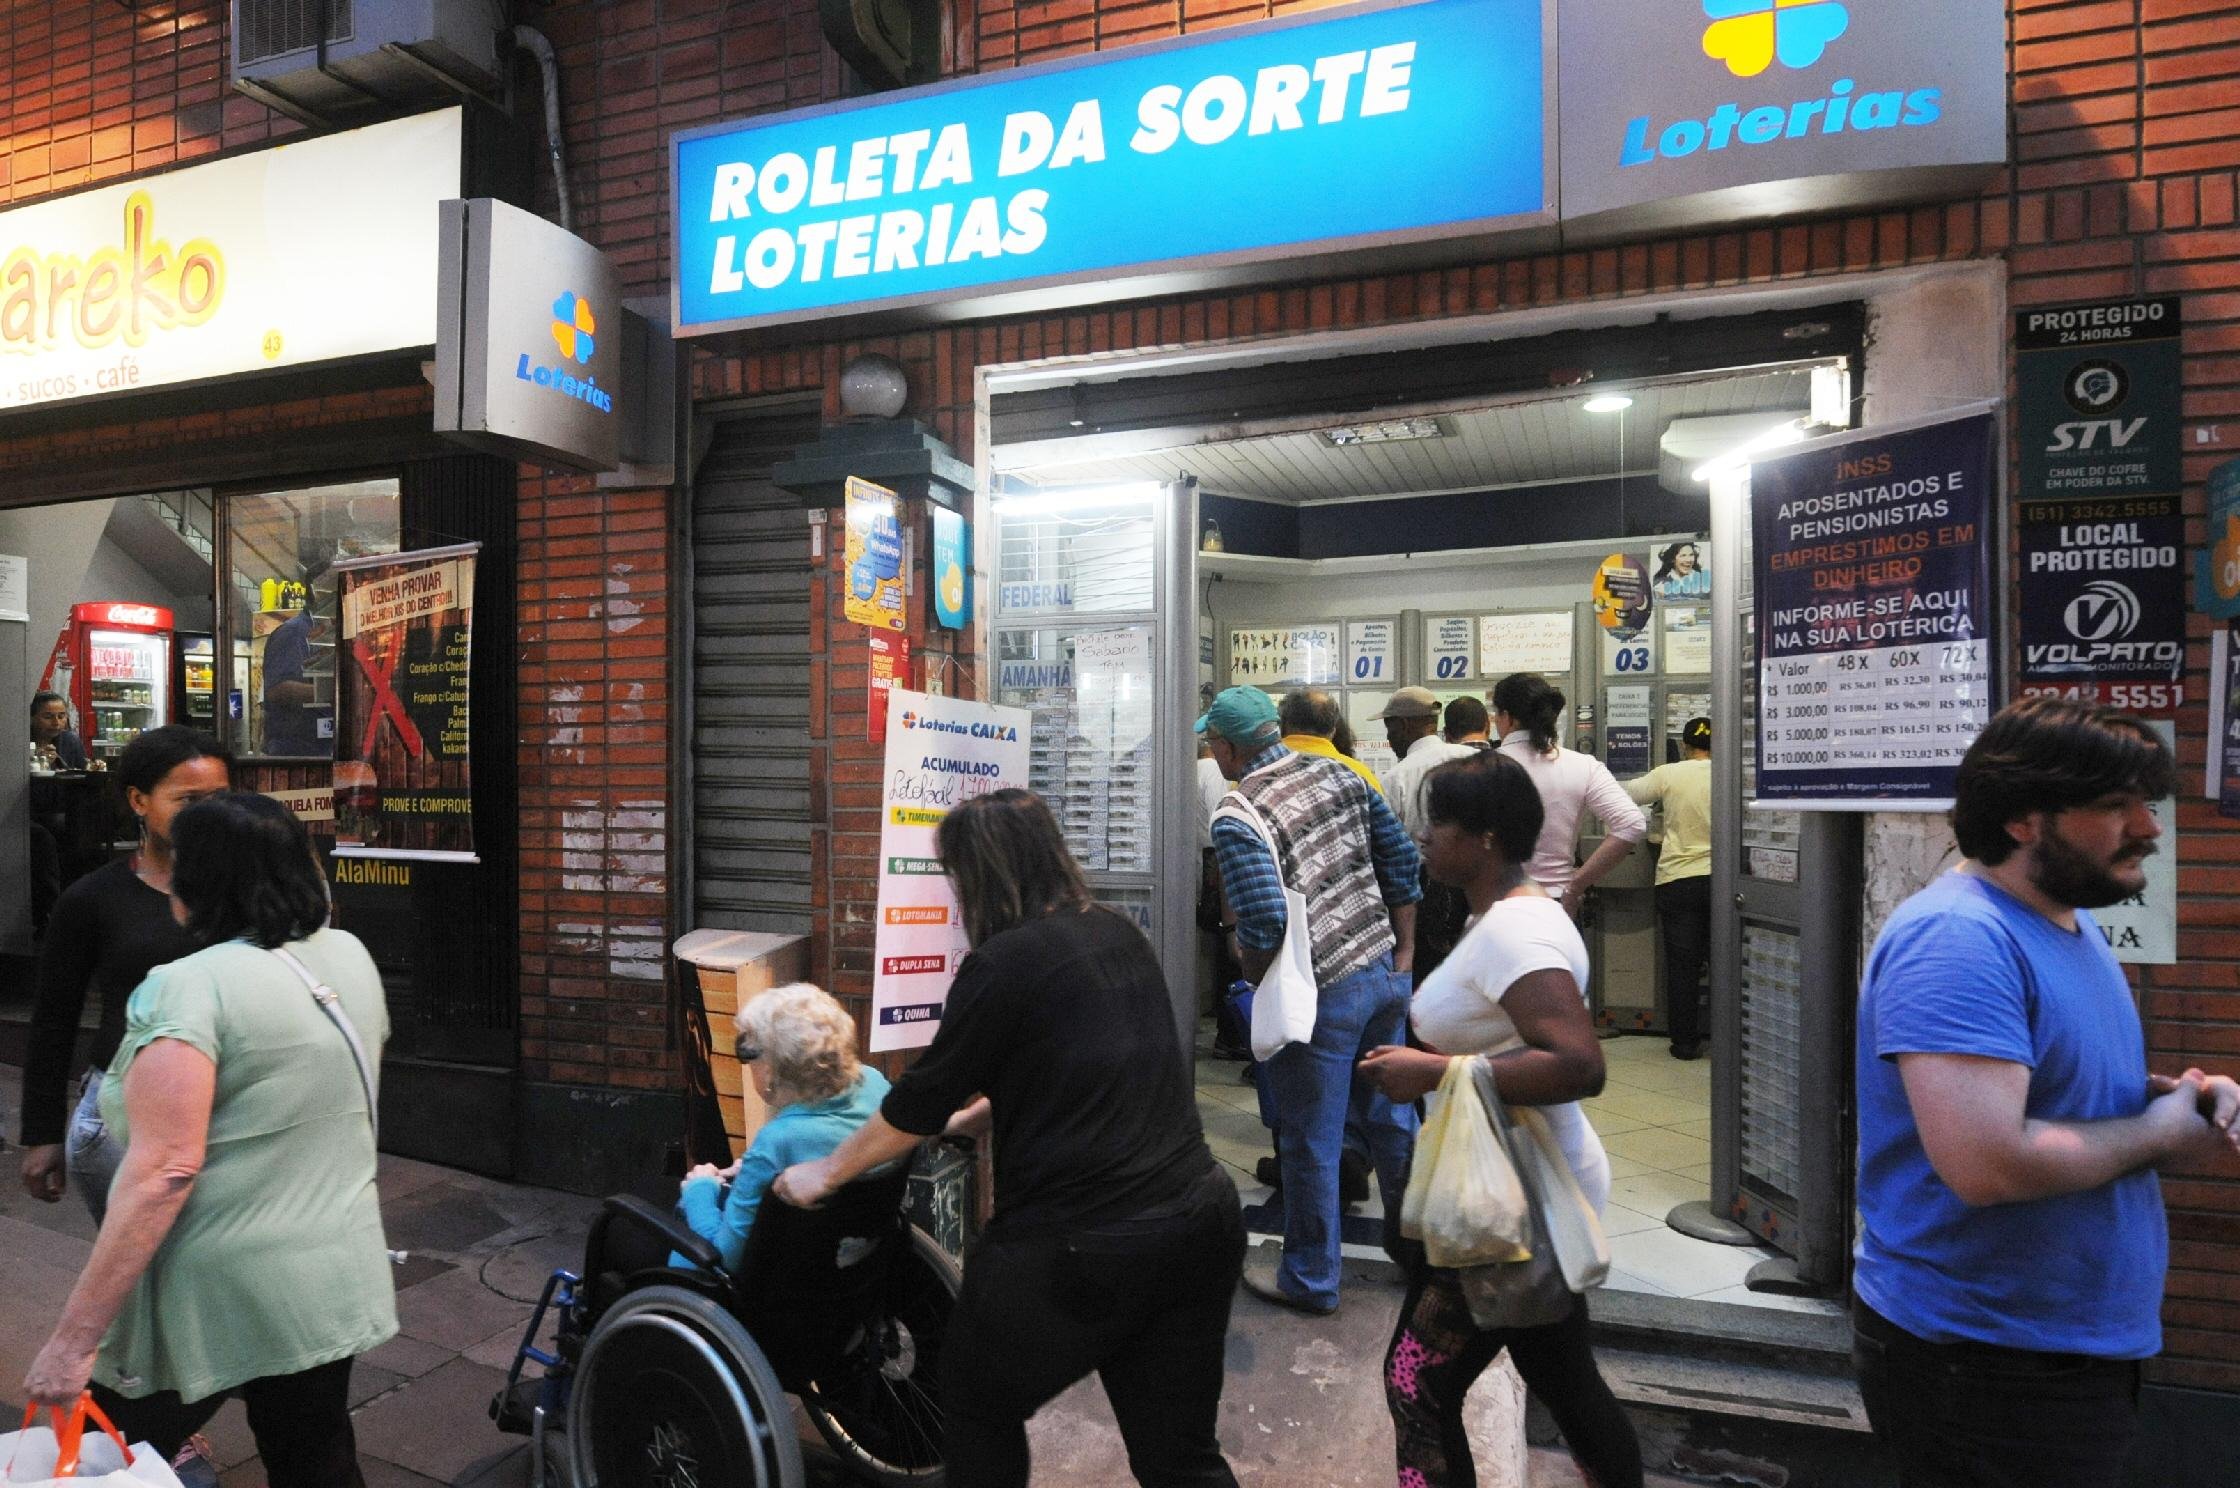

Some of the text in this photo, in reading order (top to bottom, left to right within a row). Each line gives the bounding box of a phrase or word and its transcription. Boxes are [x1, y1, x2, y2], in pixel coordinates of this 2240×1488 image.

[709, 42, 1416, 221] ROLETA DA SORTE
[1619, 78, 1942, 167] Loterias
[710, 190, 1049, 294] LOTERIAS
[2029, 303, 2164, 332] PROTEGIDO
[263, 335, 281, 353] 43
[2060, 326, 2132, 344] 24 HORAS
[18, 355, 139, 402] sucos café
[516, 353, 614, 414] Loterias
[2045, 417, 2148, 451] STV
[1837, 453, 1893, 480] INSS
[2049, 463, 2146, 478] CHAVE DO COFRE
[2046, 478, 2062, 489] EM
[2065, 477, 2103, 488] PODER
[2106, 476, 2122, 486] DA
[1777, 471, 1964, 520] APOSENTADOS E
[1789, 499, 1950, 541] PENSIONISTAS
[2028, 506, 2064, 521] (51)
[1770, 523, 1975, 570] EMPRÉSTIMOS EM
[2060, 523, 2144, 547] LOCAL
[2030, 546, 2177, 572] PROTEGIDO
[1813, 556, 1923, 590] DINHEIRO
[370, 571, 442, 605] VENHA PROVAR
[1002, 583, 1073, 609] FEDERAL
[406, 599, 417, 613] DO
[1773, 588, 1968, 627] INFORME-SE AQUI
[1291, 629, 1327, 641] BOLÃO
[1774, 612, 1975, 649] NA SUA LOTÉRICA
[1615, 647, 1650, 672] 03
[2027, 641, 2178, 663] VOLPATO
[409, 662, 438, 676] Coração
[1002, 660, 1072, 688] AMANHÃ
[1354, 655, 1383, 679] 01
[1436, 655, 1469, 679] 02
[1779, 661, 1810, 677] Valor
[413, 692, 437, 705] Frango
[1767, 685, 1778, 697] R$
[1786, 682, 1827, 696] 1.000,00
[2110, 685, 2183, 710] 5551
[1767, 707, 1778, 719] R$
[1785, 705, 1828, 718] 3.000,00
[919, 716, 1017, 742] Loterias CAIXA
[1767, 730, 1778, 741] R$
[1785, 727, 1828, 741] 5.000,00
[1955, 723, 1986, 732] 150,2
[921, 756, 1000, 777] ACUMULADO
[1767, 753, 1778, 764] R$
[1780, 751, 1828, 764] 10.000,00
[382, 797, 472, 814] PROVE E COMPROVE
[335, 858, 411, 886] AlaMinu
[902, 910, 943, 921] LOTOMANIA
[900, 959, 940, 971] DUPLA SENA
[904, 1007, 931, 1021] QUINA
